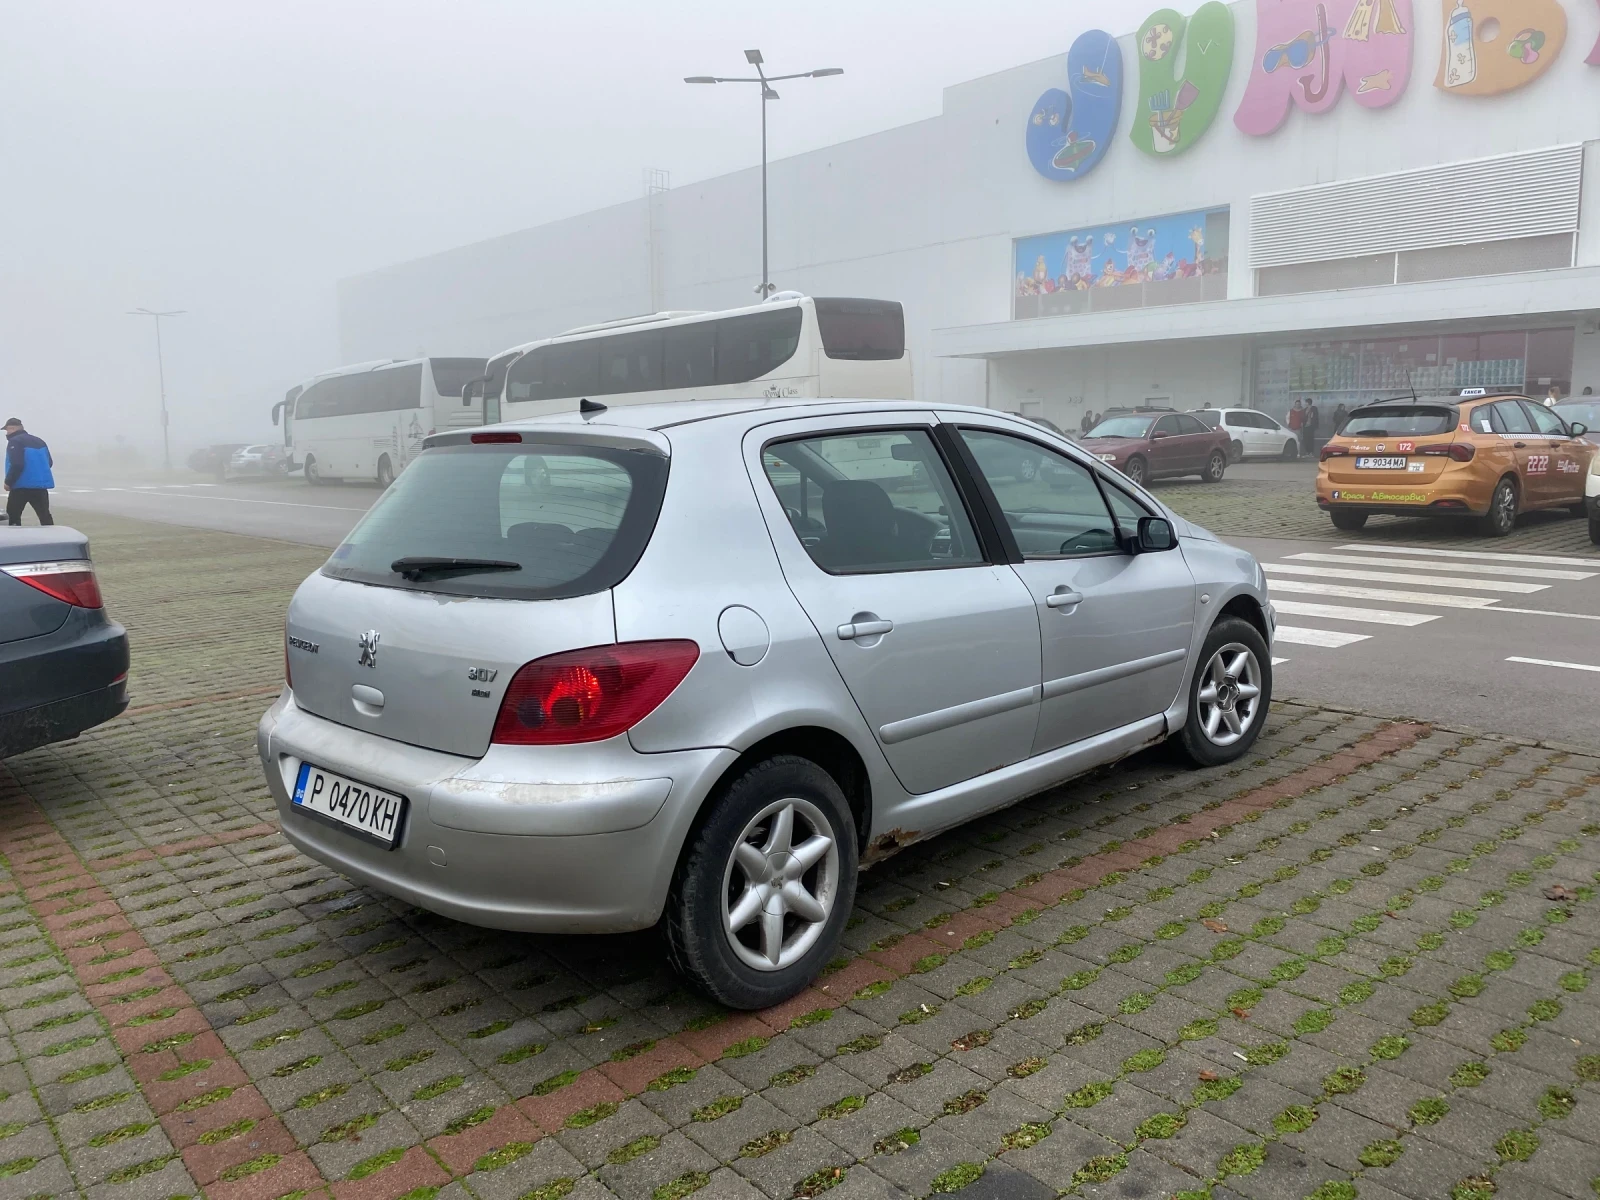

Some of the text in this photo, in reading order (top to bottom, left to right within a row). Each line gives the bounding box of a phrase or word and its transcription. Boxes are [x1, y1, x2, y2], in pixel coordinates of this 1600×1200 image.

[1026, 0, 1600, 181] JUMB
[782, 387, 798, 397] Class
[1399, 443, 1411, 451] 172
[1341, 491, 1364, 500] Краси
[289, 635, 320, 654] PEUGEOT
[468, 666, 498, 682] 307
[310, 773, 324, 804] P
